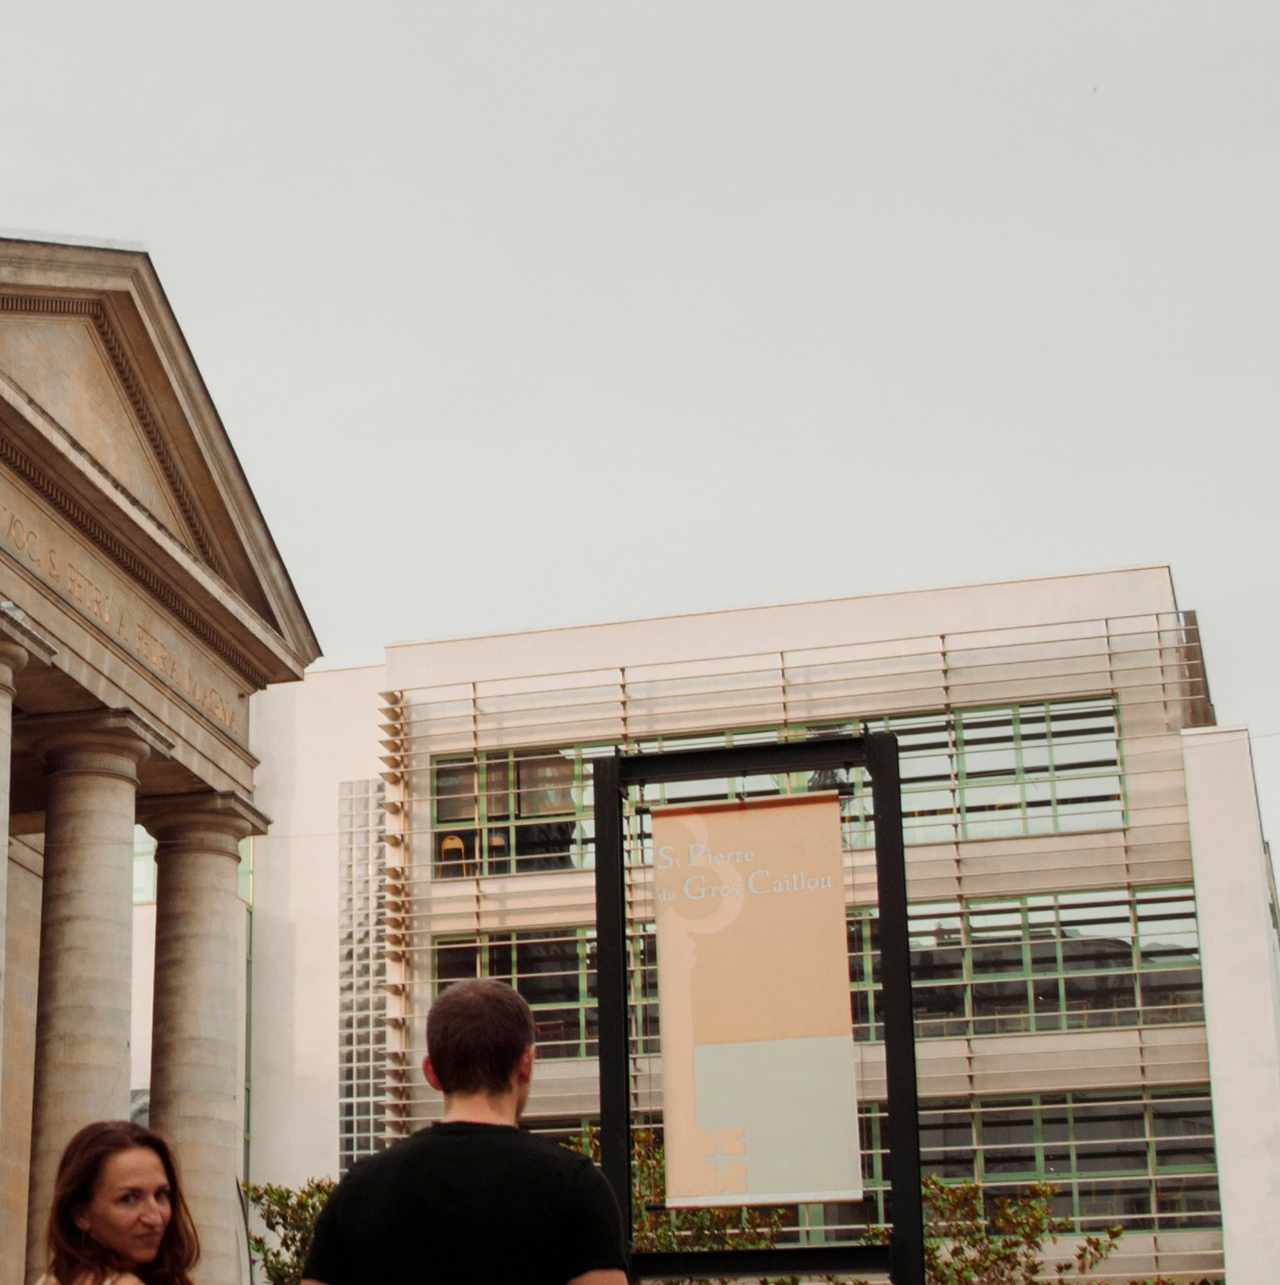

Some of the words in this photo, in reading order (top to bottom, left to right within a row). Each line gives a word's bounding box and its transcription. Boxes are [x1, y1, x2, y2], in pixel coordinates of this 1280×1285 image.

[67, 560, 110, 625] PETRI
[186, 663, 240, 736] MAGNA
[657, 846, 681, 869] St
[687, 843, 754, 866] Pierre
[658, 888, 677, 902] du
[682, 874, 742, 900] Gros
[746, 869, 832, 895] Caillou
